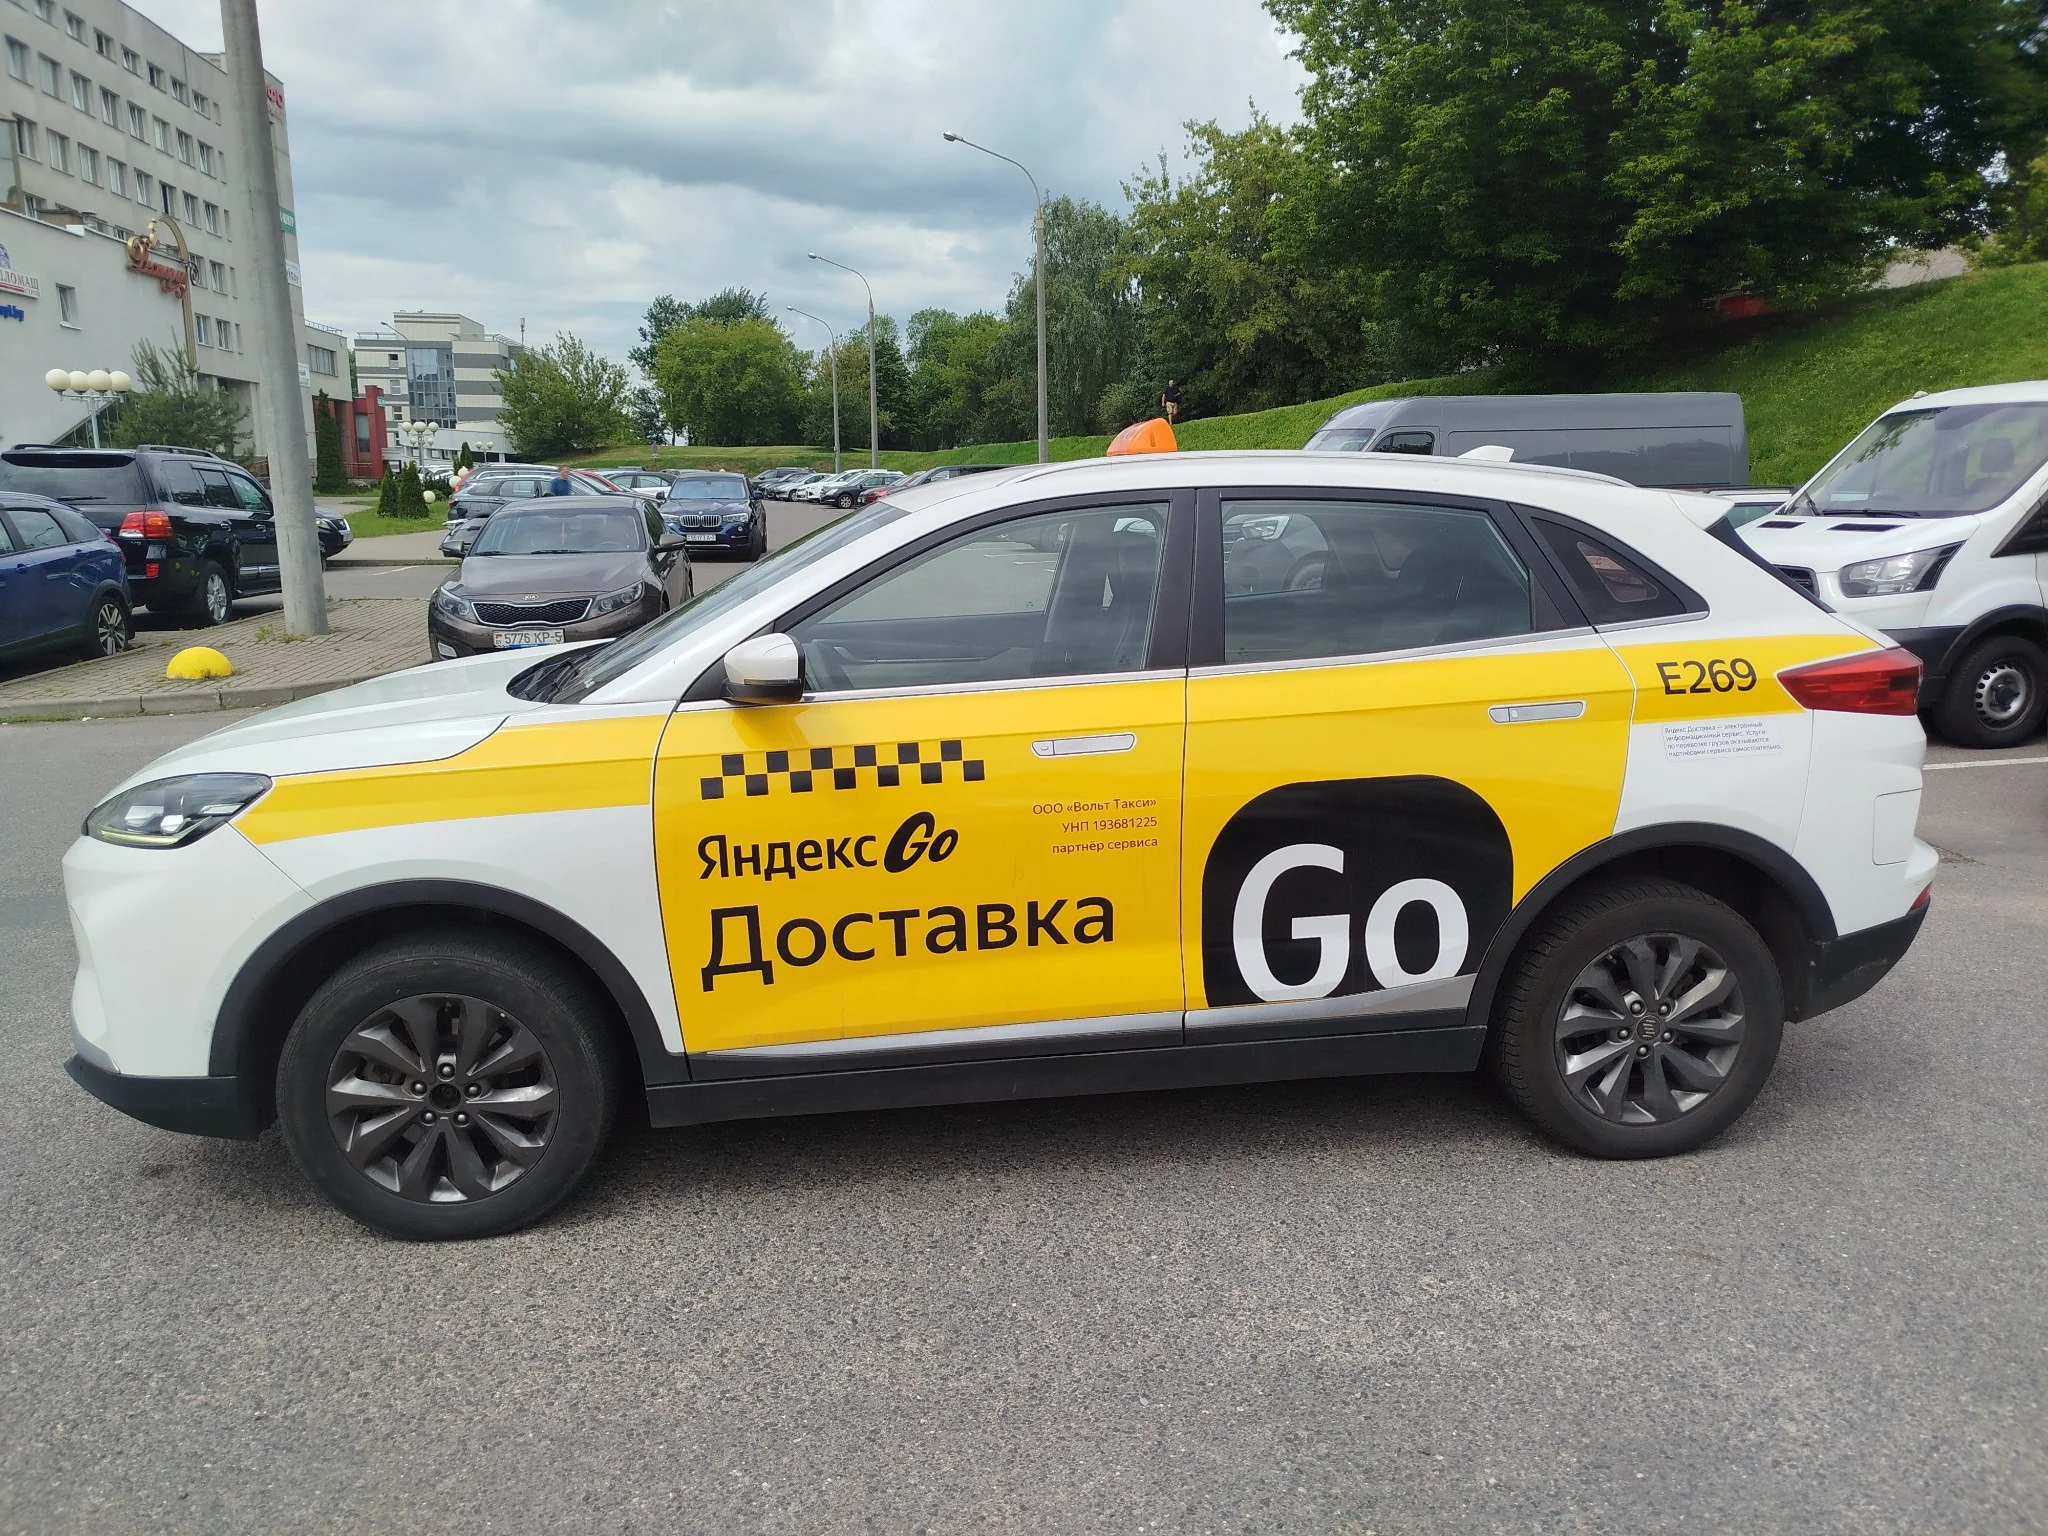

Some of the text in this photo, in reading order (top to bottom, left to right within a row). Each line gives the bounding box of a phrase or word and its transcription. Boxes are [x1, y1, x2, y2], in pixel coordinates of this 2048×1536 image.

[504, 632, 531, 644] 5776
[533, 631, 563, 644] KP-5
[1656, 657, 1757, 695] E269
[1687, 725, 1715, 733] Доставка
[1745, 729, 1766, 738] Услуги
[1706, 747, 1731, 756] сервиса
[1708, 739, 1730, 748] грузов
[1032, 798, 1157, 815] ООО «Вольт Такси»
[1061, 816, 1158, 834] УНП 193681225
[884, 810, 959, 874] Go
[1052, 837, 1158, 855] партнёр сервиса
[697, 832, 878, 882] Яндекс
[1232, 842, 1469, 1003] Go
[700, 893, 1116, 993] Доставка
